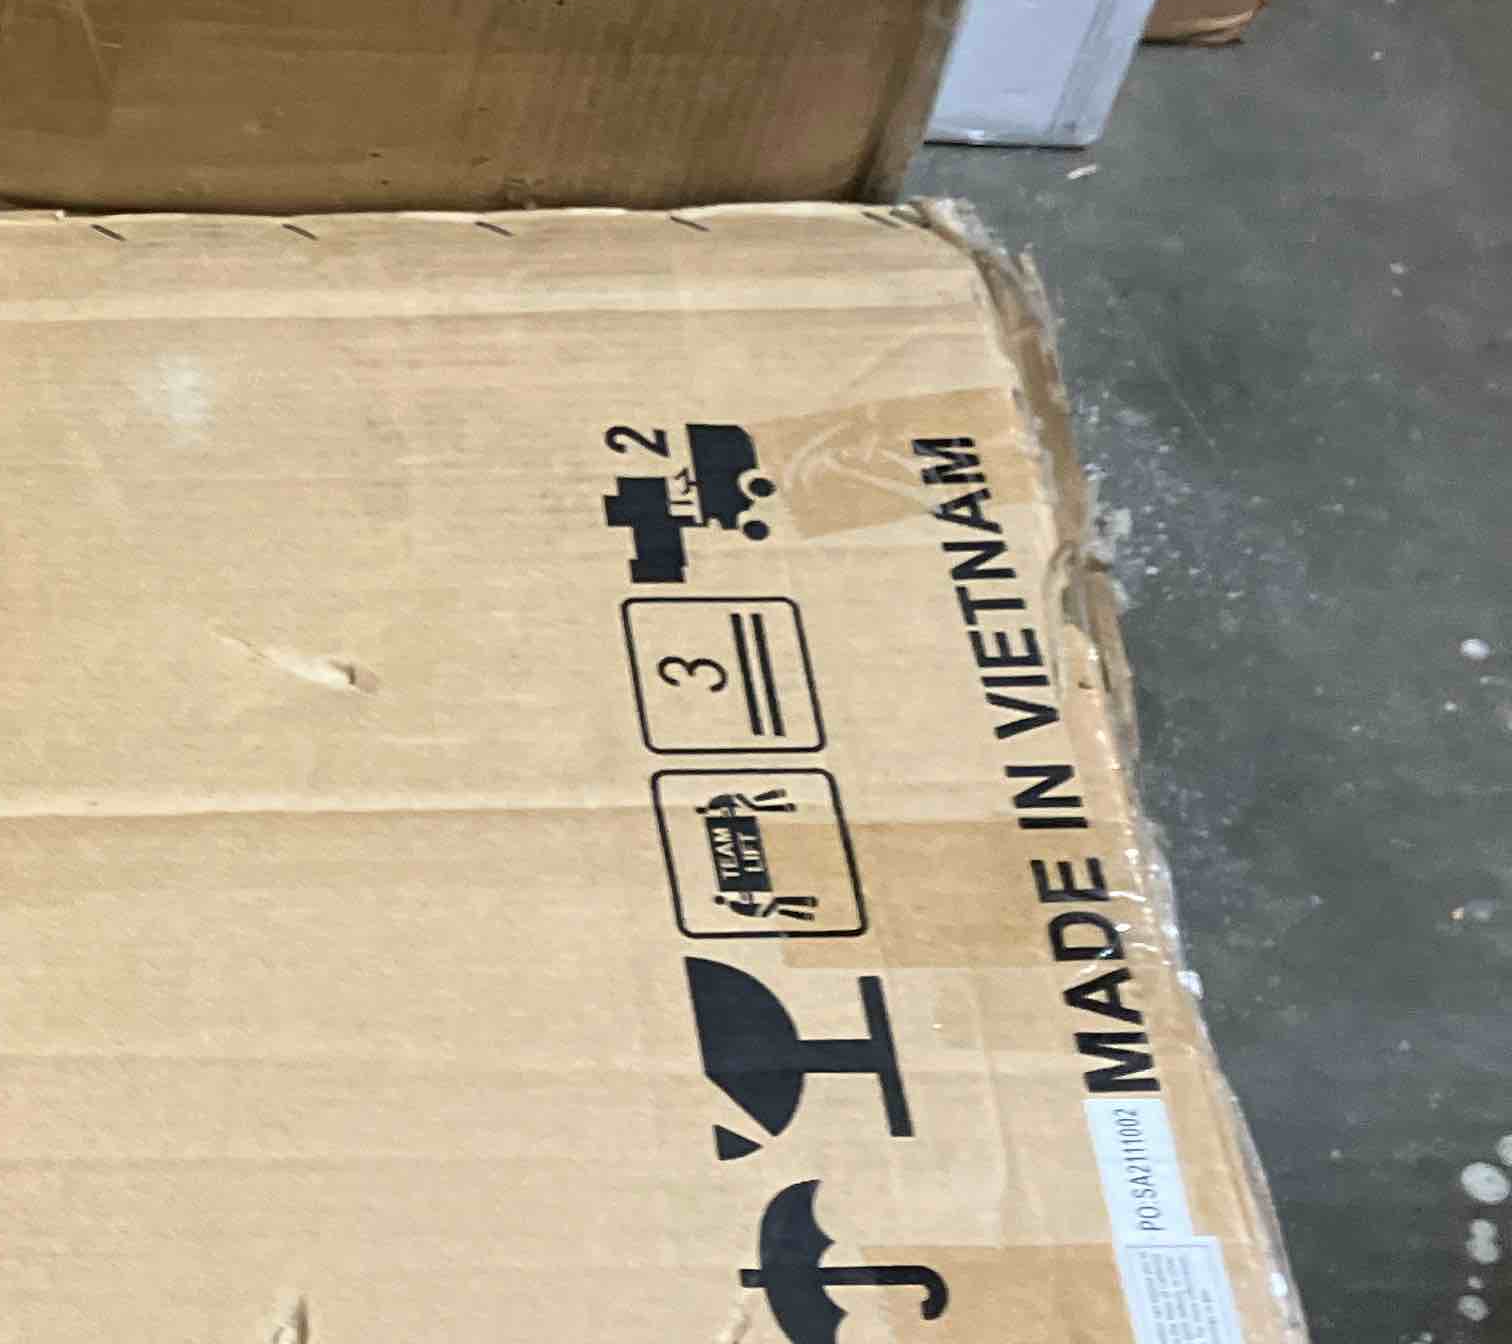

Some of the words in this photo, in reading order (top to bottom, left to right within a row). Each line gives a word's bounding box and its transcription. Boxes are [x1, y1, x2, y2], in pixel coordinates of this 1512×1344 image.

[604, 425, 670, 456] 2
[912, 436, 1062, 739] VIETNAM
[657, 655, 729, 693] 3
[1004, 764, 1090, 830] IN
[711, 827, 741, 881] TEAM
[736, 834, 765, 873] LIFT
[1031, 857, 1162, 1093] MADE
